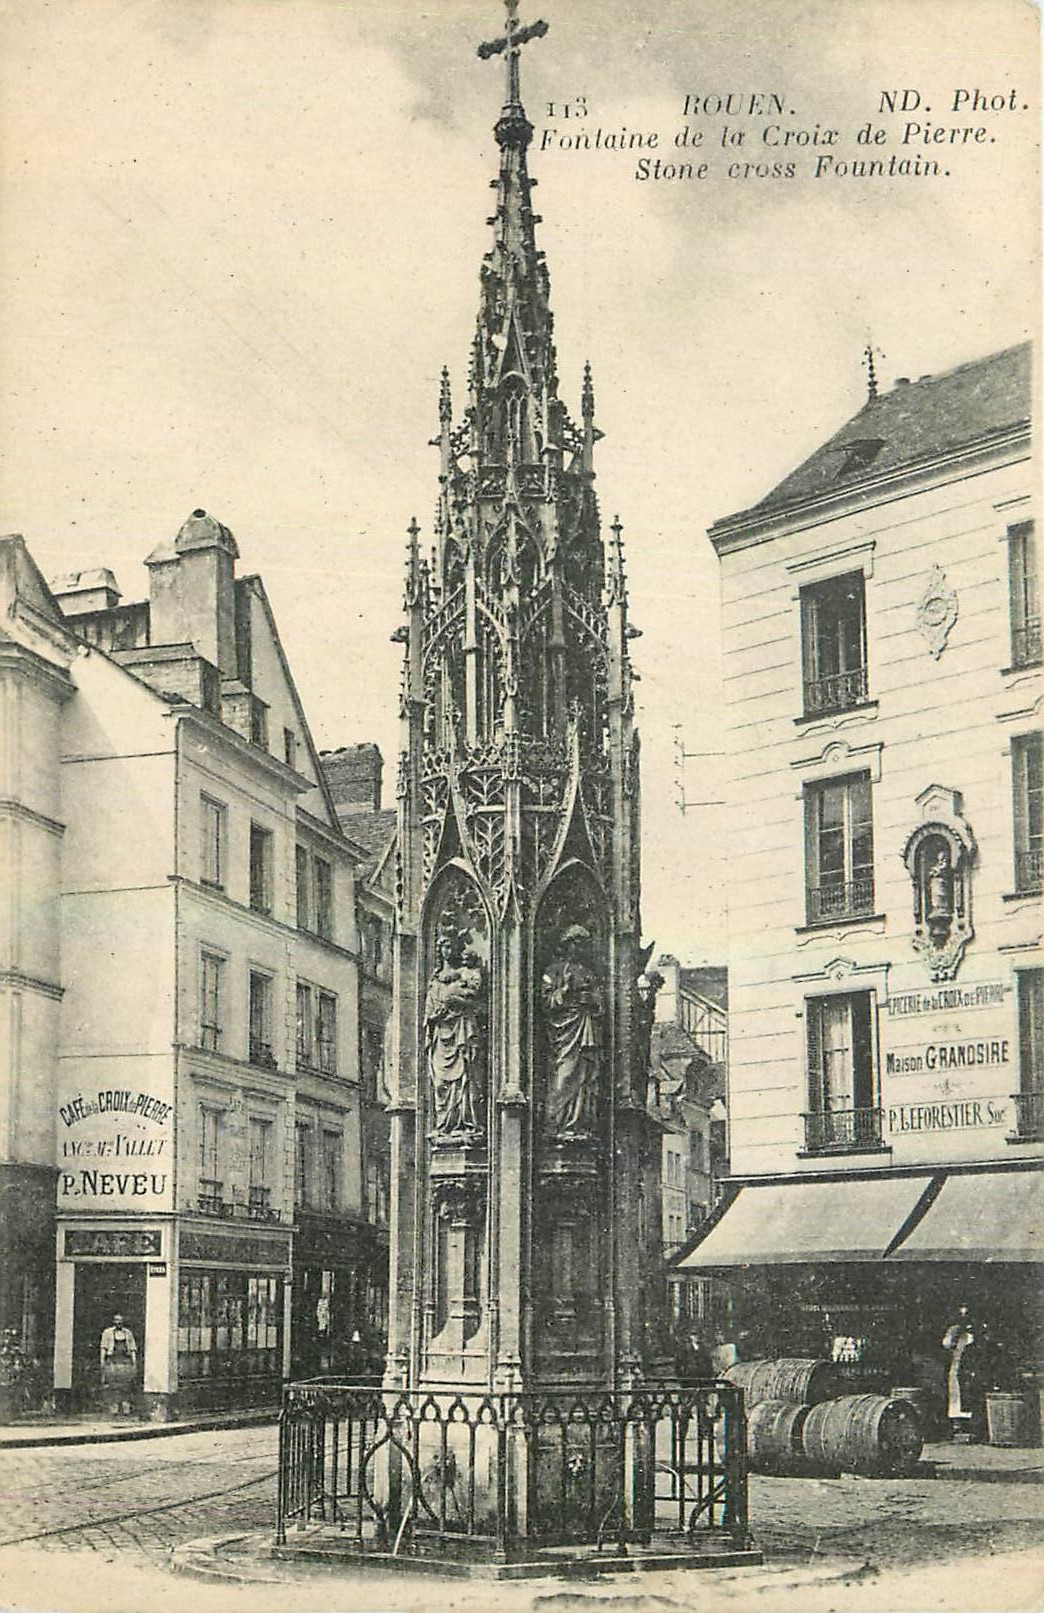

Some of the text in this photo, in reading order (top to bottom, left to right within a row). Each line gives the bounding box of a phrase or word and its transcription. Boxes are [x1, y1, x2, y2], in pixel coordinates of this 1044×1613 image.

[886, 1041, 1009, 1076] Maison GRANDSIRE
[98, 1090, 132, 1113] CROIX
[134, 1093, 173, 1126] PIERRE
